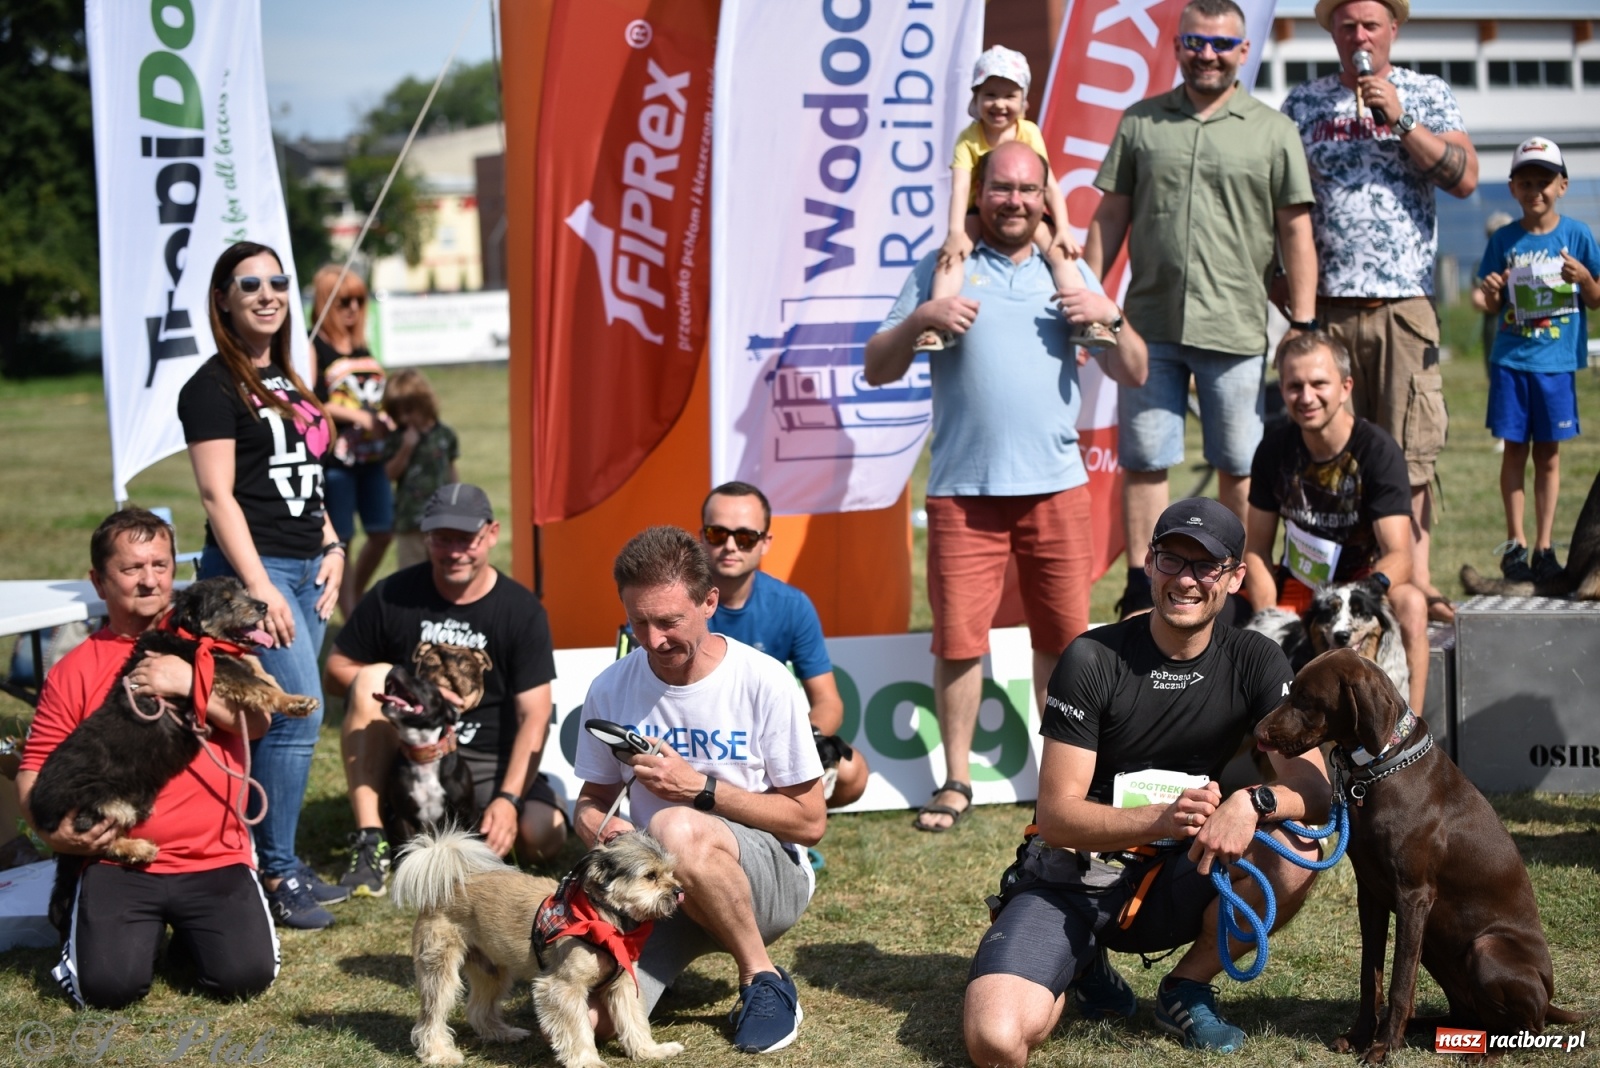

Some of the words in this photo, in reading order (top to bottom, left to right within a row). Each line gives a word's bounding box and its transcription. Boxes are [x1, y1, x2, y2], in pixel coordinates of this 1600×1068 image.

[616, 58, 691, 310] FIPRex
[1535, 291, 1553, 306] 12
[1298, 557, 1313, 575] 18
[1529, 744, 1600, 769] OSIR
